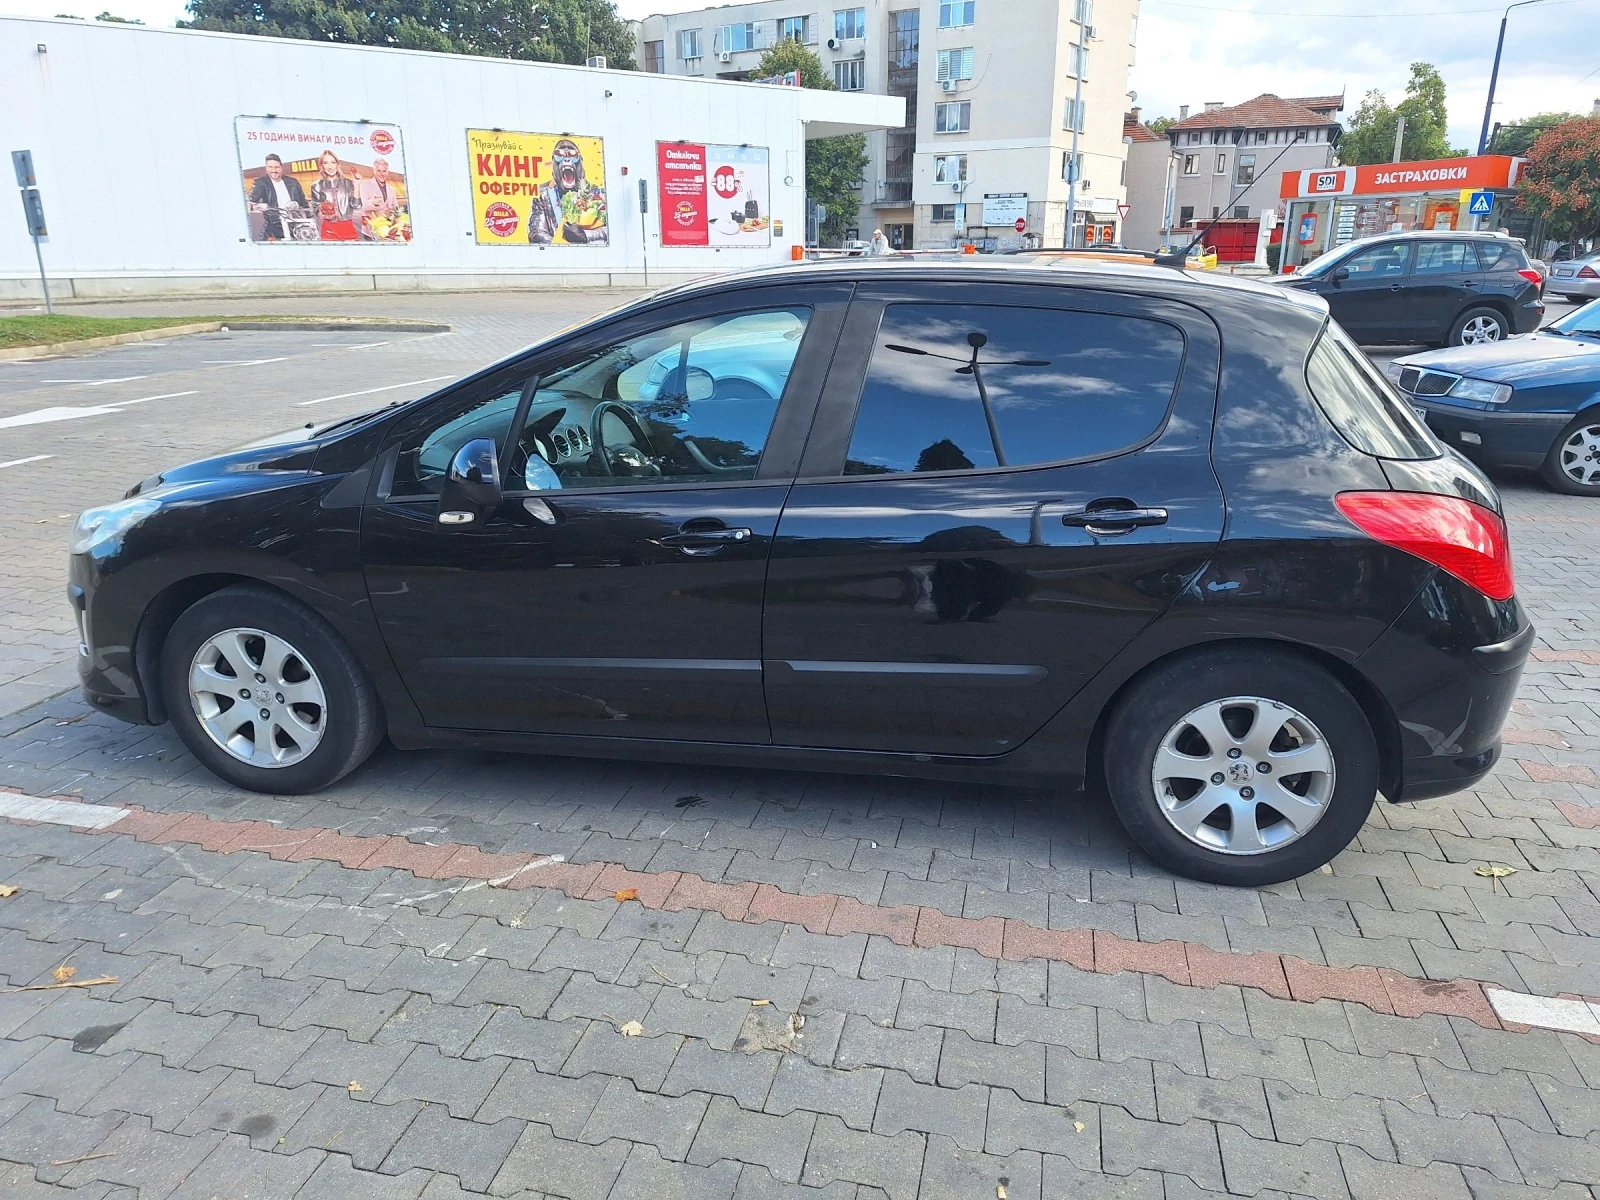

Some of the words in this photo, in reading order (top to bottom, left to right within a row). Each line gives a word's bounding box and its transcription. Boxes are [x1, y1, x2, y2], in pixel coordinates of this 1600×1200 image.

[247, 132, 258, 140] 25
[260, 132, 296, 142] ГОДИНИ
[298, 133, 332, 144] ВИНАГИ
[334, 136, 346, 145] ДО
[348, 136, 365, 145] ВАС
[473, 139, 516, 153] Празнувай
[666, 150, 700, 160] Отключи
[291, 159, 318, 173] BILLA
[477, 154, 543, 178] КИНГ
[664, 163, 702, 171] отстъпки
[1319, 176, 1335, 186] SDI
[1374, 167, 1467, 185] ЗАСТРАХОВКИ
[480, 181, 538, 196] ОФЕРТИ
